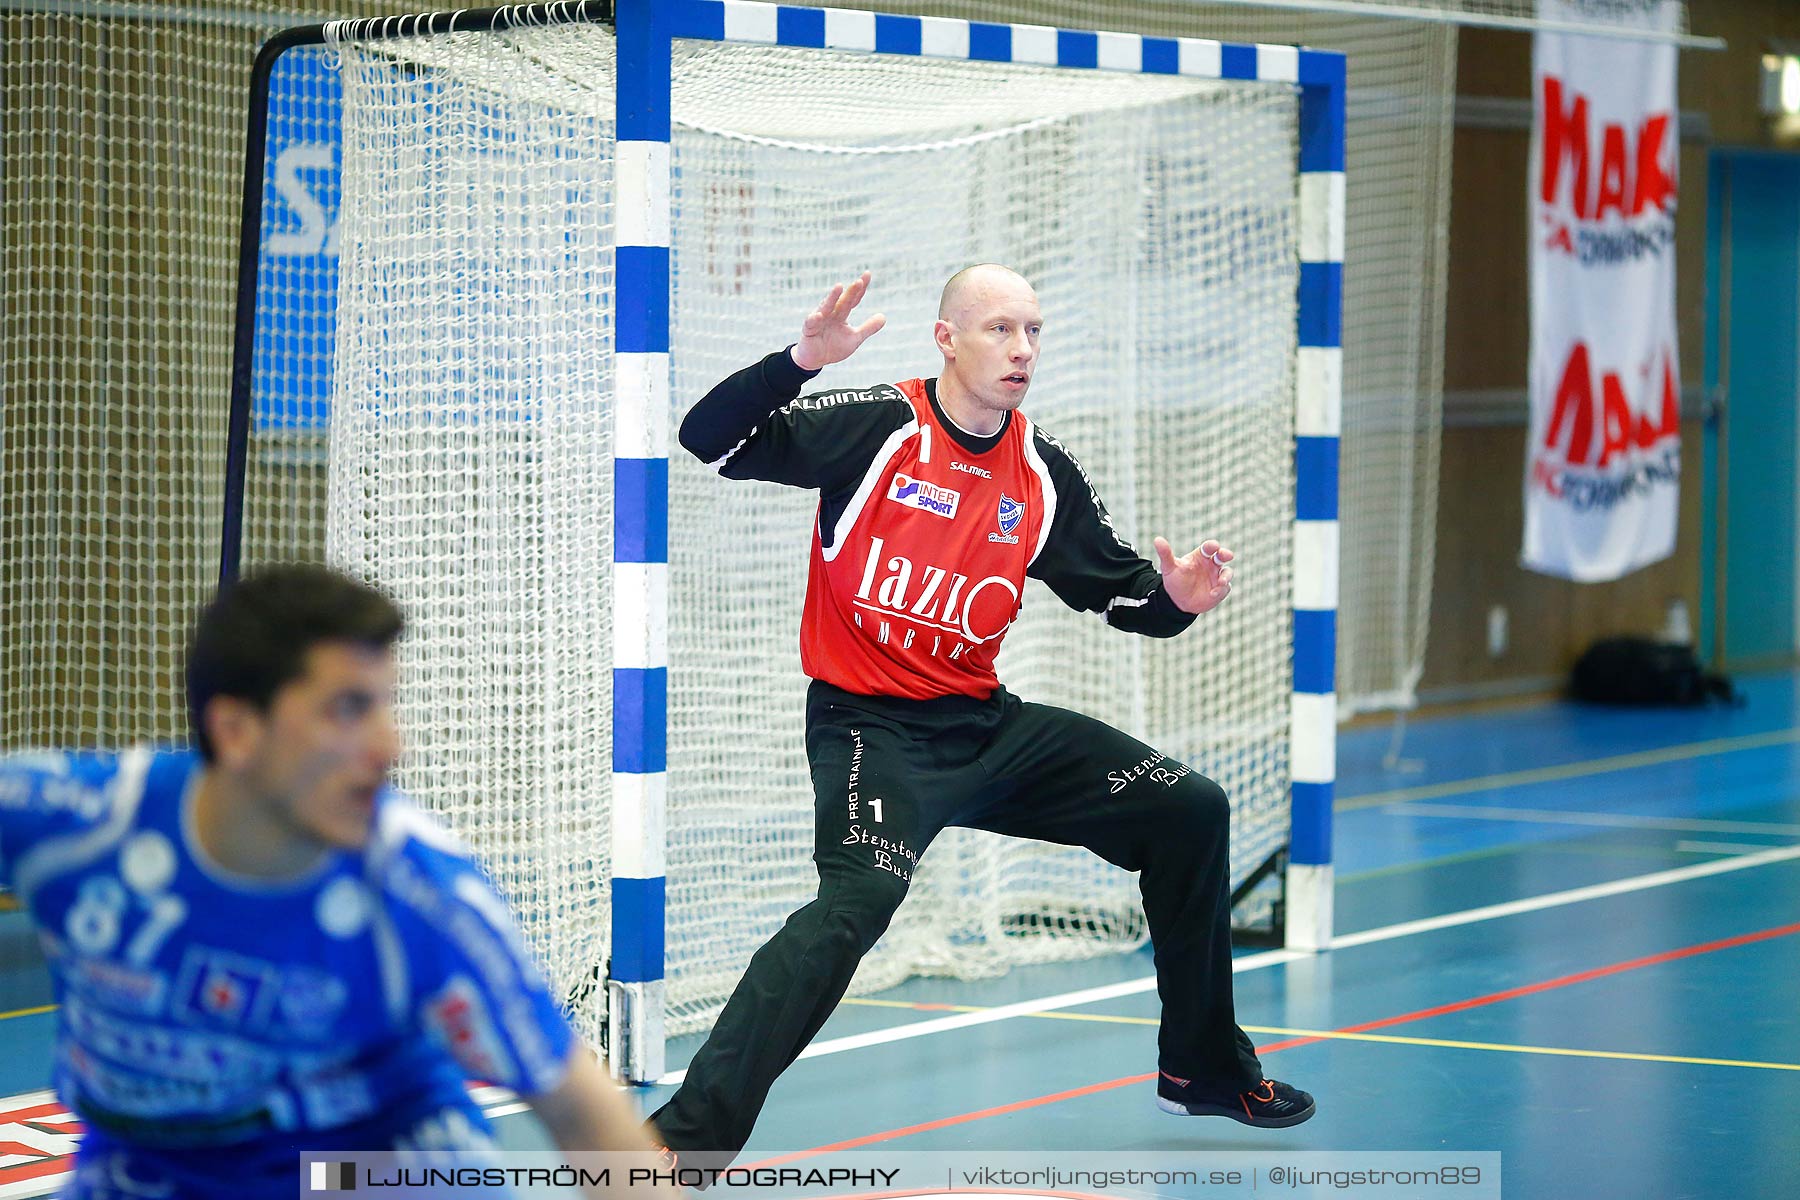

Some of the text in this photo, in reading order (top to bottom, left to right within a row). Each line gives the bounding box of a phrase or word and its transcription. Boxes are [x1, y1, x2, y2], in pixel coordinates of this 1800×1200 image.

[919, 423, 931, 464] 1
[917, 495, 953, 515] SPORT
[919, 484, 955, 504] INTER
[848, 792, 859, 820] PRO
[867, 798, 883, 823] 1
